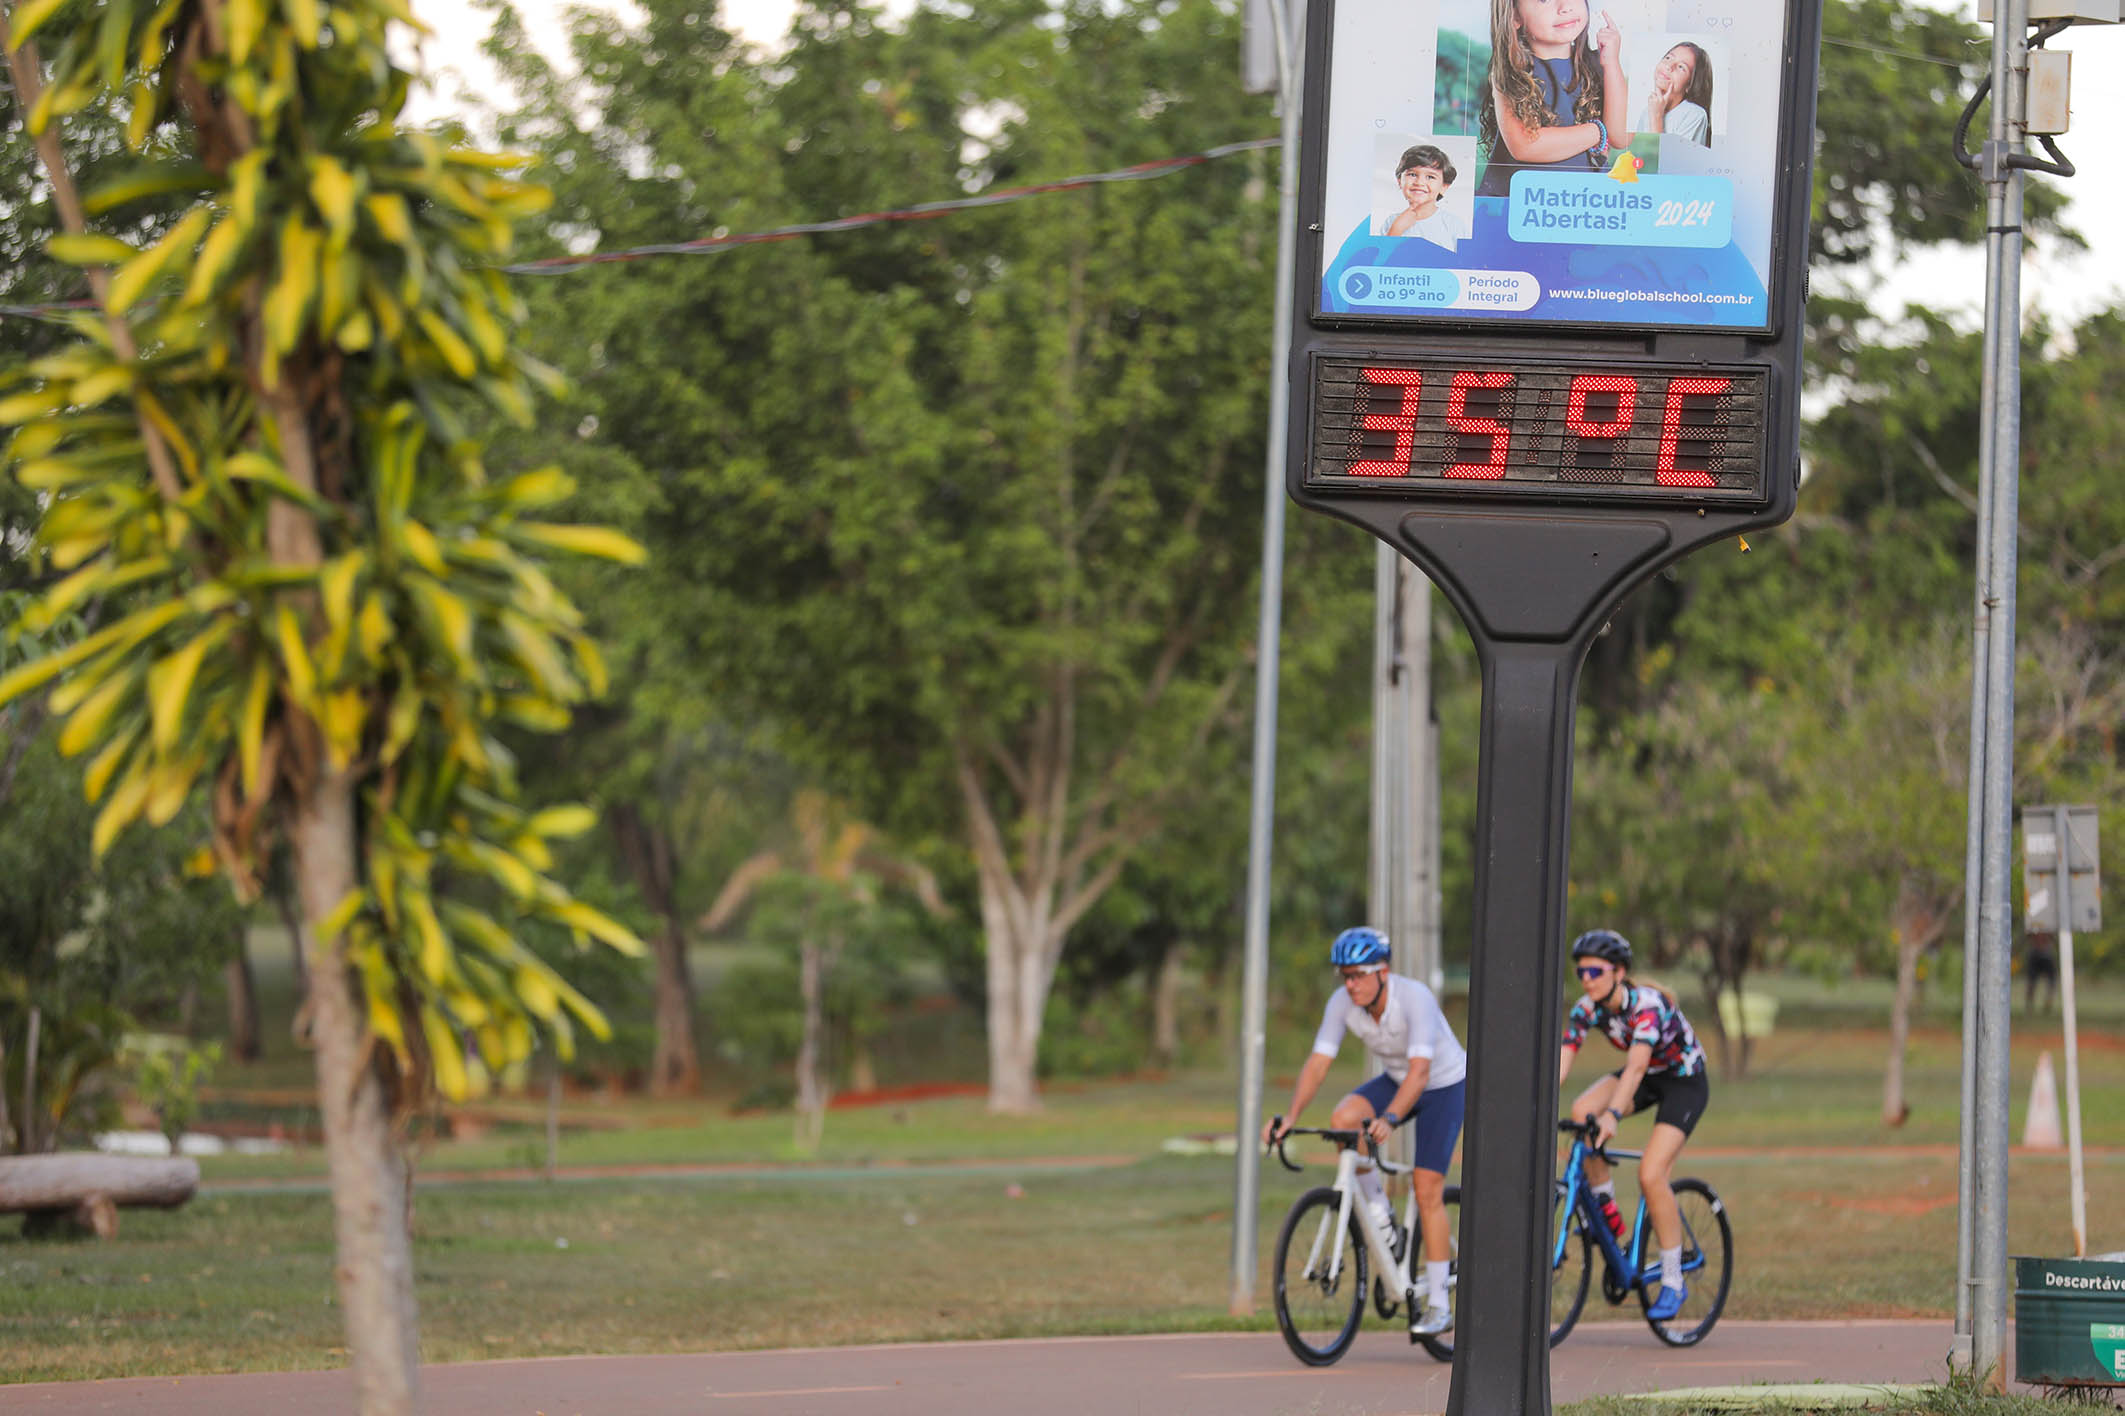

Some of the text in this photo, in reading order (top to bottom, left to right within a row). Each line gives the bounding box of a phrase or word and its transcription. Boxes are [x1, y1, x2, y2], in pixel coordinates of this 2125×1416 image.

[1524, 187, 1653, 210] Matrículas
[1522, 208, 1627, 230] Abertas!
[1655, 200, 1716, 227] 2024
[1378, 274, 1431, 287] Infantil
[1468, 276, 1520, 289] Período
[1378, 289, 1396, 300] ao
[1418, 292, 1446, 302] ano
[1468, 291, 1518, 304] Integral
[1549, 288, 1754, 305] www.blueglobalschool.com.br
